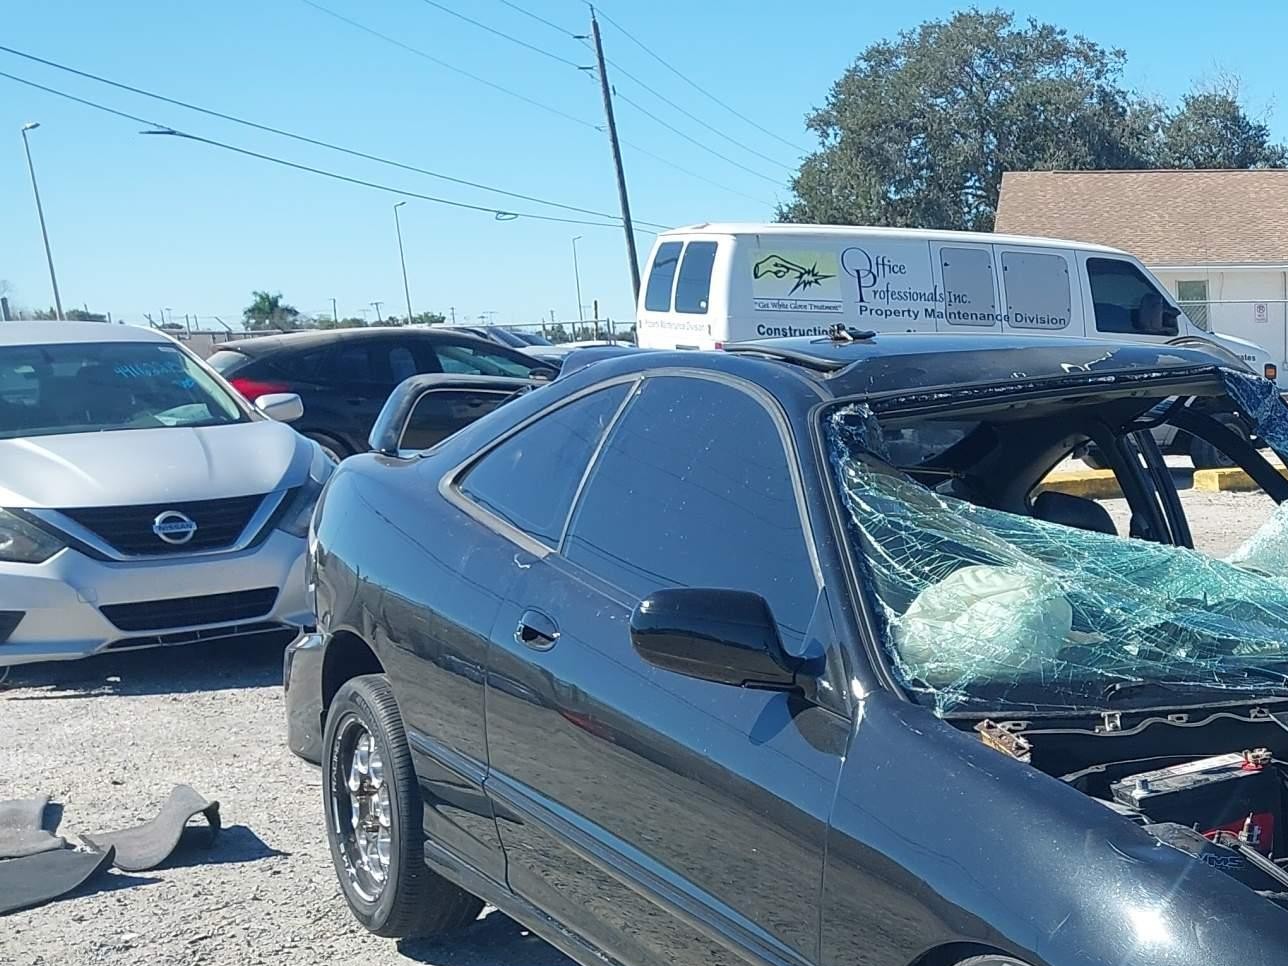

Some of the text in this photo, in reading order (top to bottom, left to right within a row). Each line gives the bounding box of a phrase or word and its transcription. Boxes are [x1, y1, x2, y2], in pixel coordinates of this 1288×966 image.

[841, 247, 907, 279] Office
[855, 268, 972, 306] Professionals Inc.
[859, 305, 1067, 325] Property Maintenance Division
